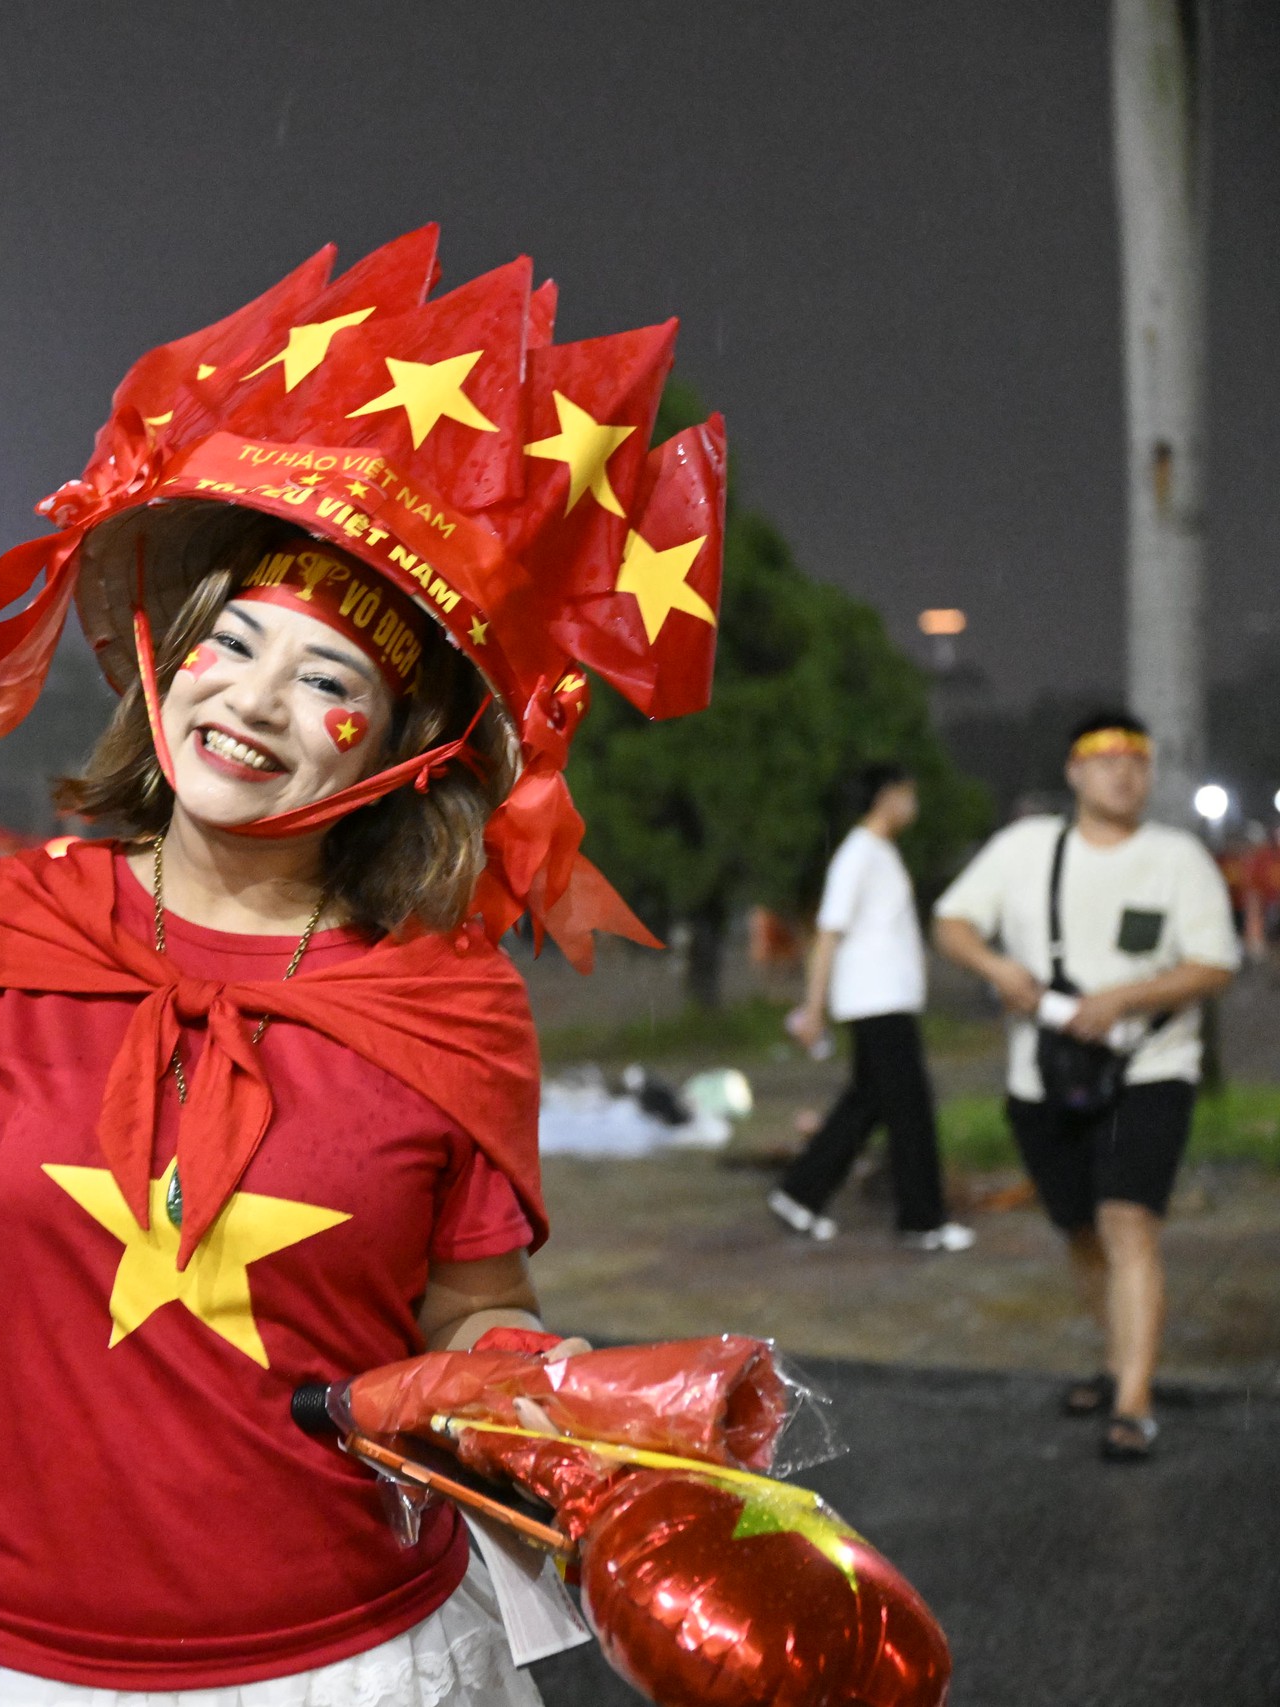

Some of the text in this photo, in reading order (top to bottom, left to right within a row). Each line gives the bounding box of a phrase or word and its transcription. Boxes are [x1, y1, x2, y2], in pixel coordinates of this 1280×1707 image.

[342, 456, 399, 488] VIỆT
[395, 486, 458, 539] NAM
[241, 552, 297, 587] AM
[338, 578, 383, 629] VÔ
[315, 497, 462, 614] VIỆT NAM
